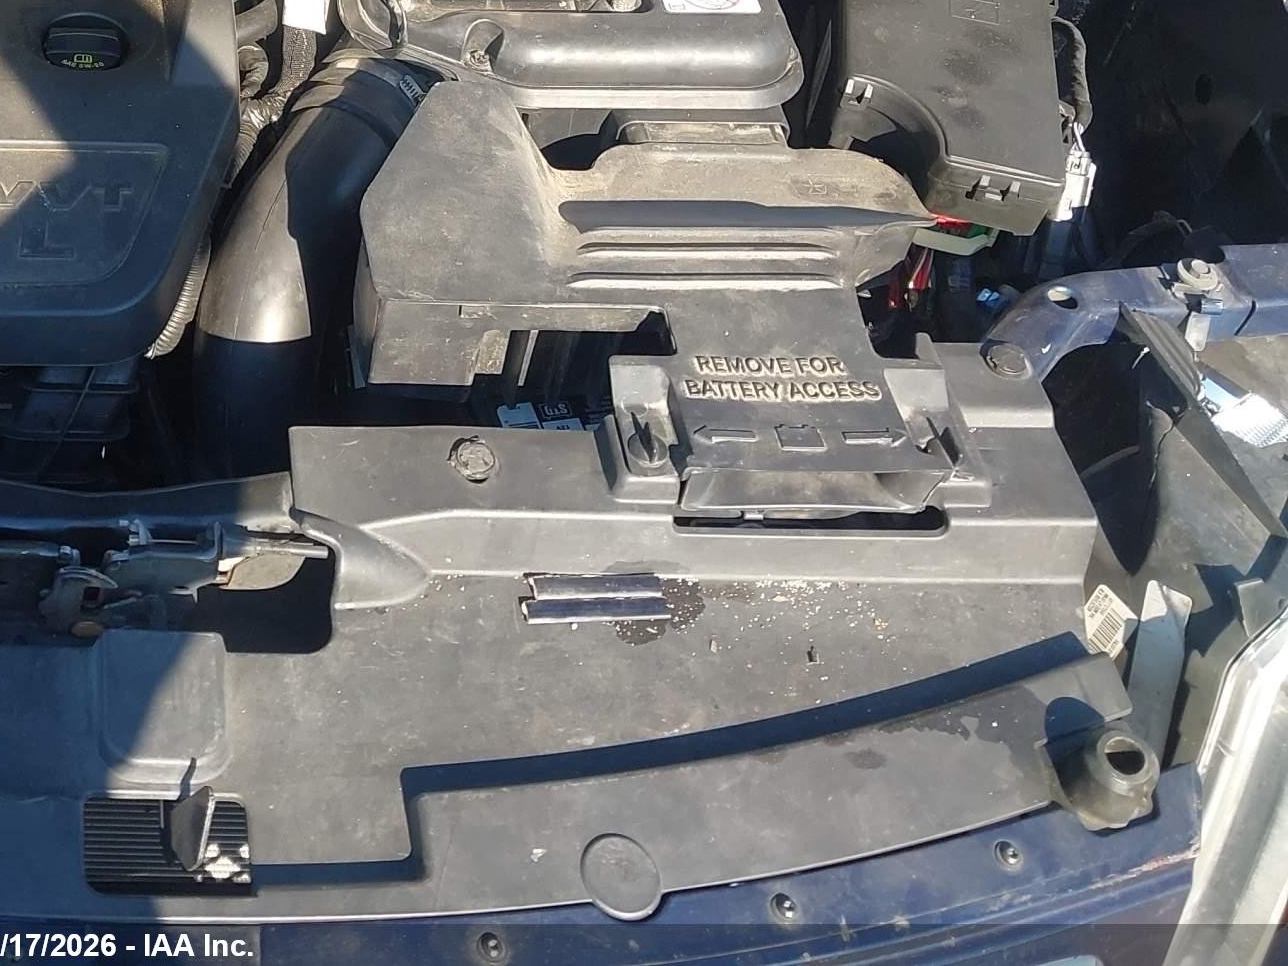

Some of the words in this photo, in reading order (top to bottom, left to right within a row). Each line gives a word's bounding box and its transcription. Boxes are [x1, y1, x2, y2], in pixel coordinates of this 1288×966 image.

[695, 355, 792, 376] REMOVE
[795, 355, 847, 377] FOR
[684, 379, 783, 401] BATTERY
[789, 381, 883, 401] ACCESS
